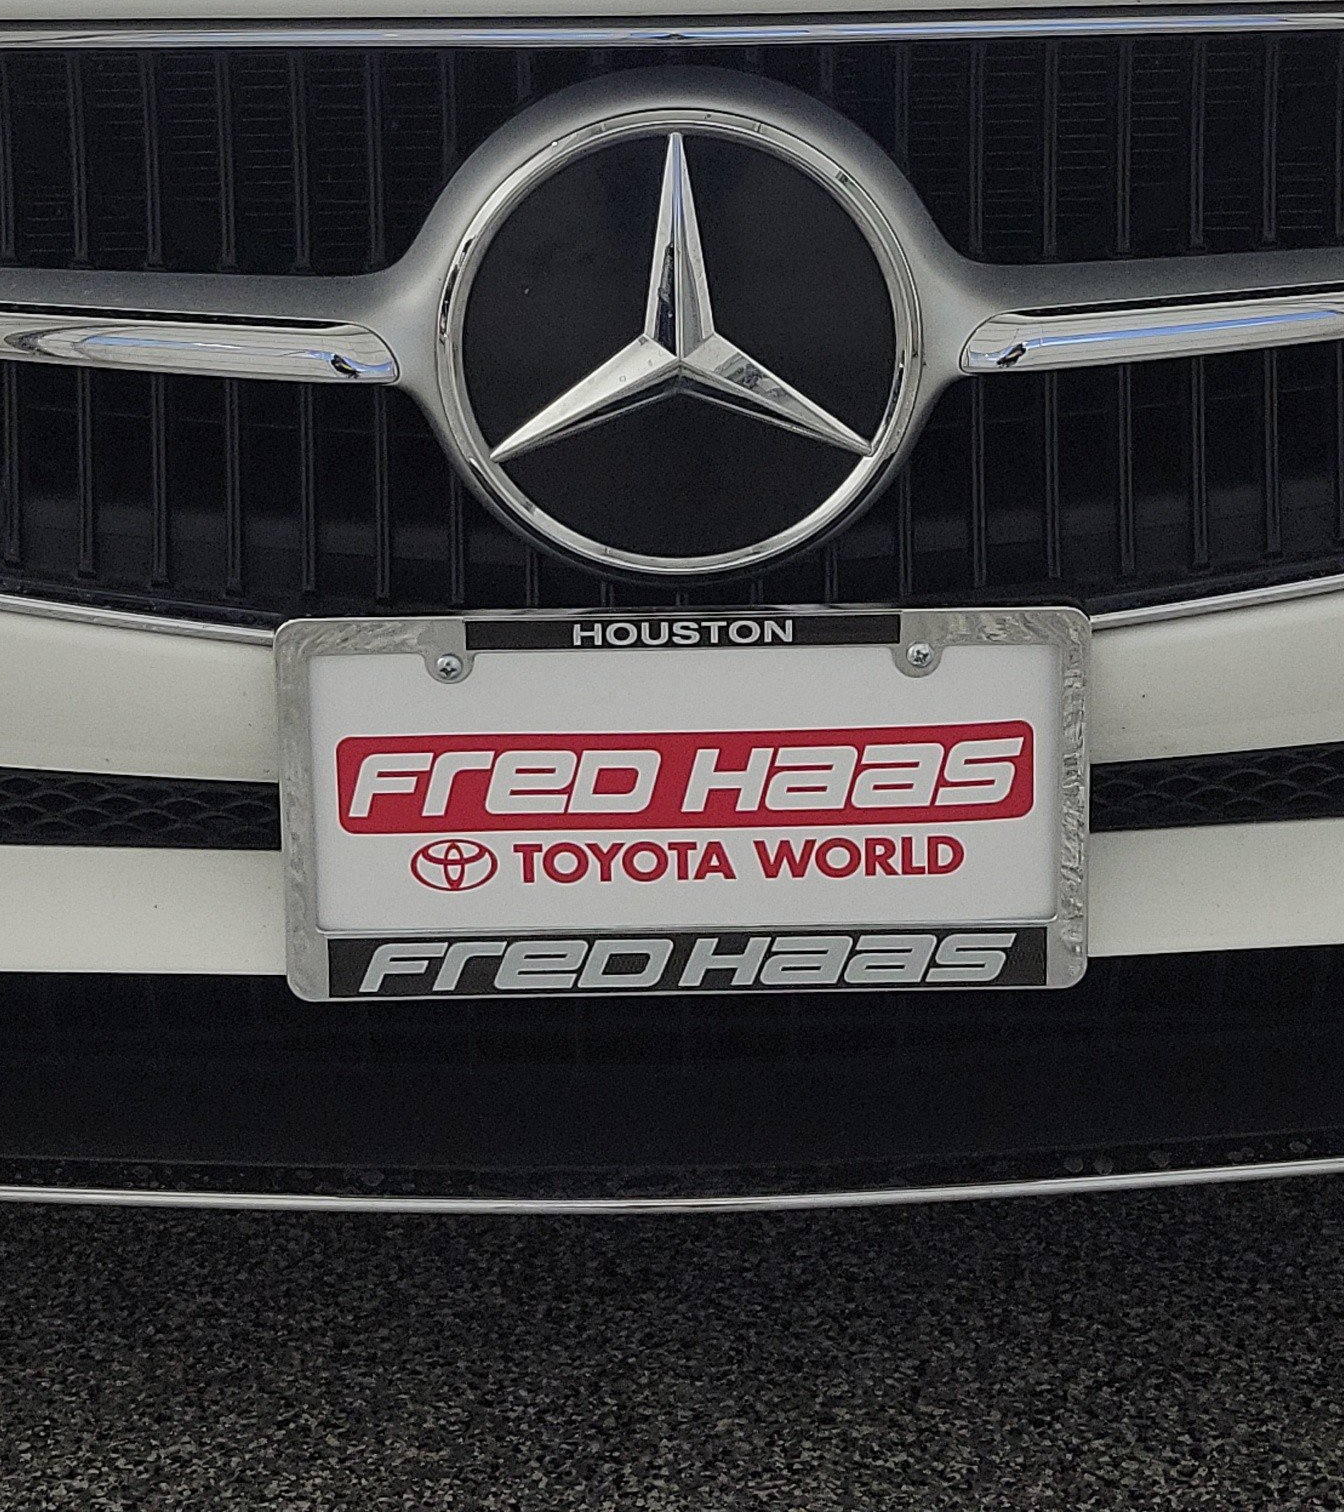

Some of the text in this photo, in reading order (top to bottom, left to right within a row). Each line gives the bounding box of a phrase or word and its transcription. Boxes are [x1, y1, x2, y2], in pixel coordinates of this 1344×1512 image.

[573, 619, 793, 646] HOUSTON
[513, 835, 965, 883] TOYOTA WORLD
